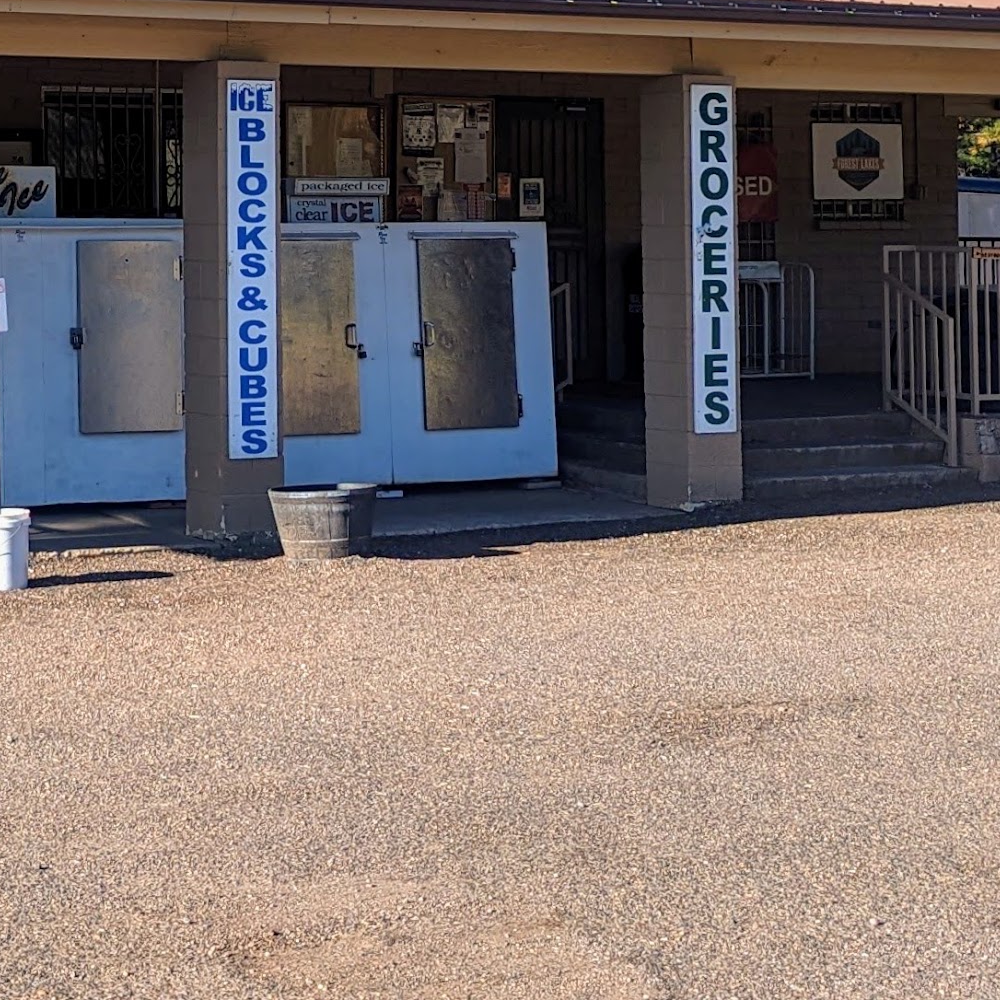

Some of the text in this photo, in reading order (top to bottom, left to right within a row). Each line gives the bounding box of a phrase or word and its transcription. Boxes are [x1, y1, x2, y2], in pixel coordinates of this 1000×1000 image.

[230, 83, 273, 112] ICE
[301, 181, 363, 192] packaged
[295, 207, 329, 221] clear
[296, 199, 375, 223] crystal ICE
[699, 92, 730, 426] GROCERIES
[236, 118, 268, 455] BLOCKS & CUBES
